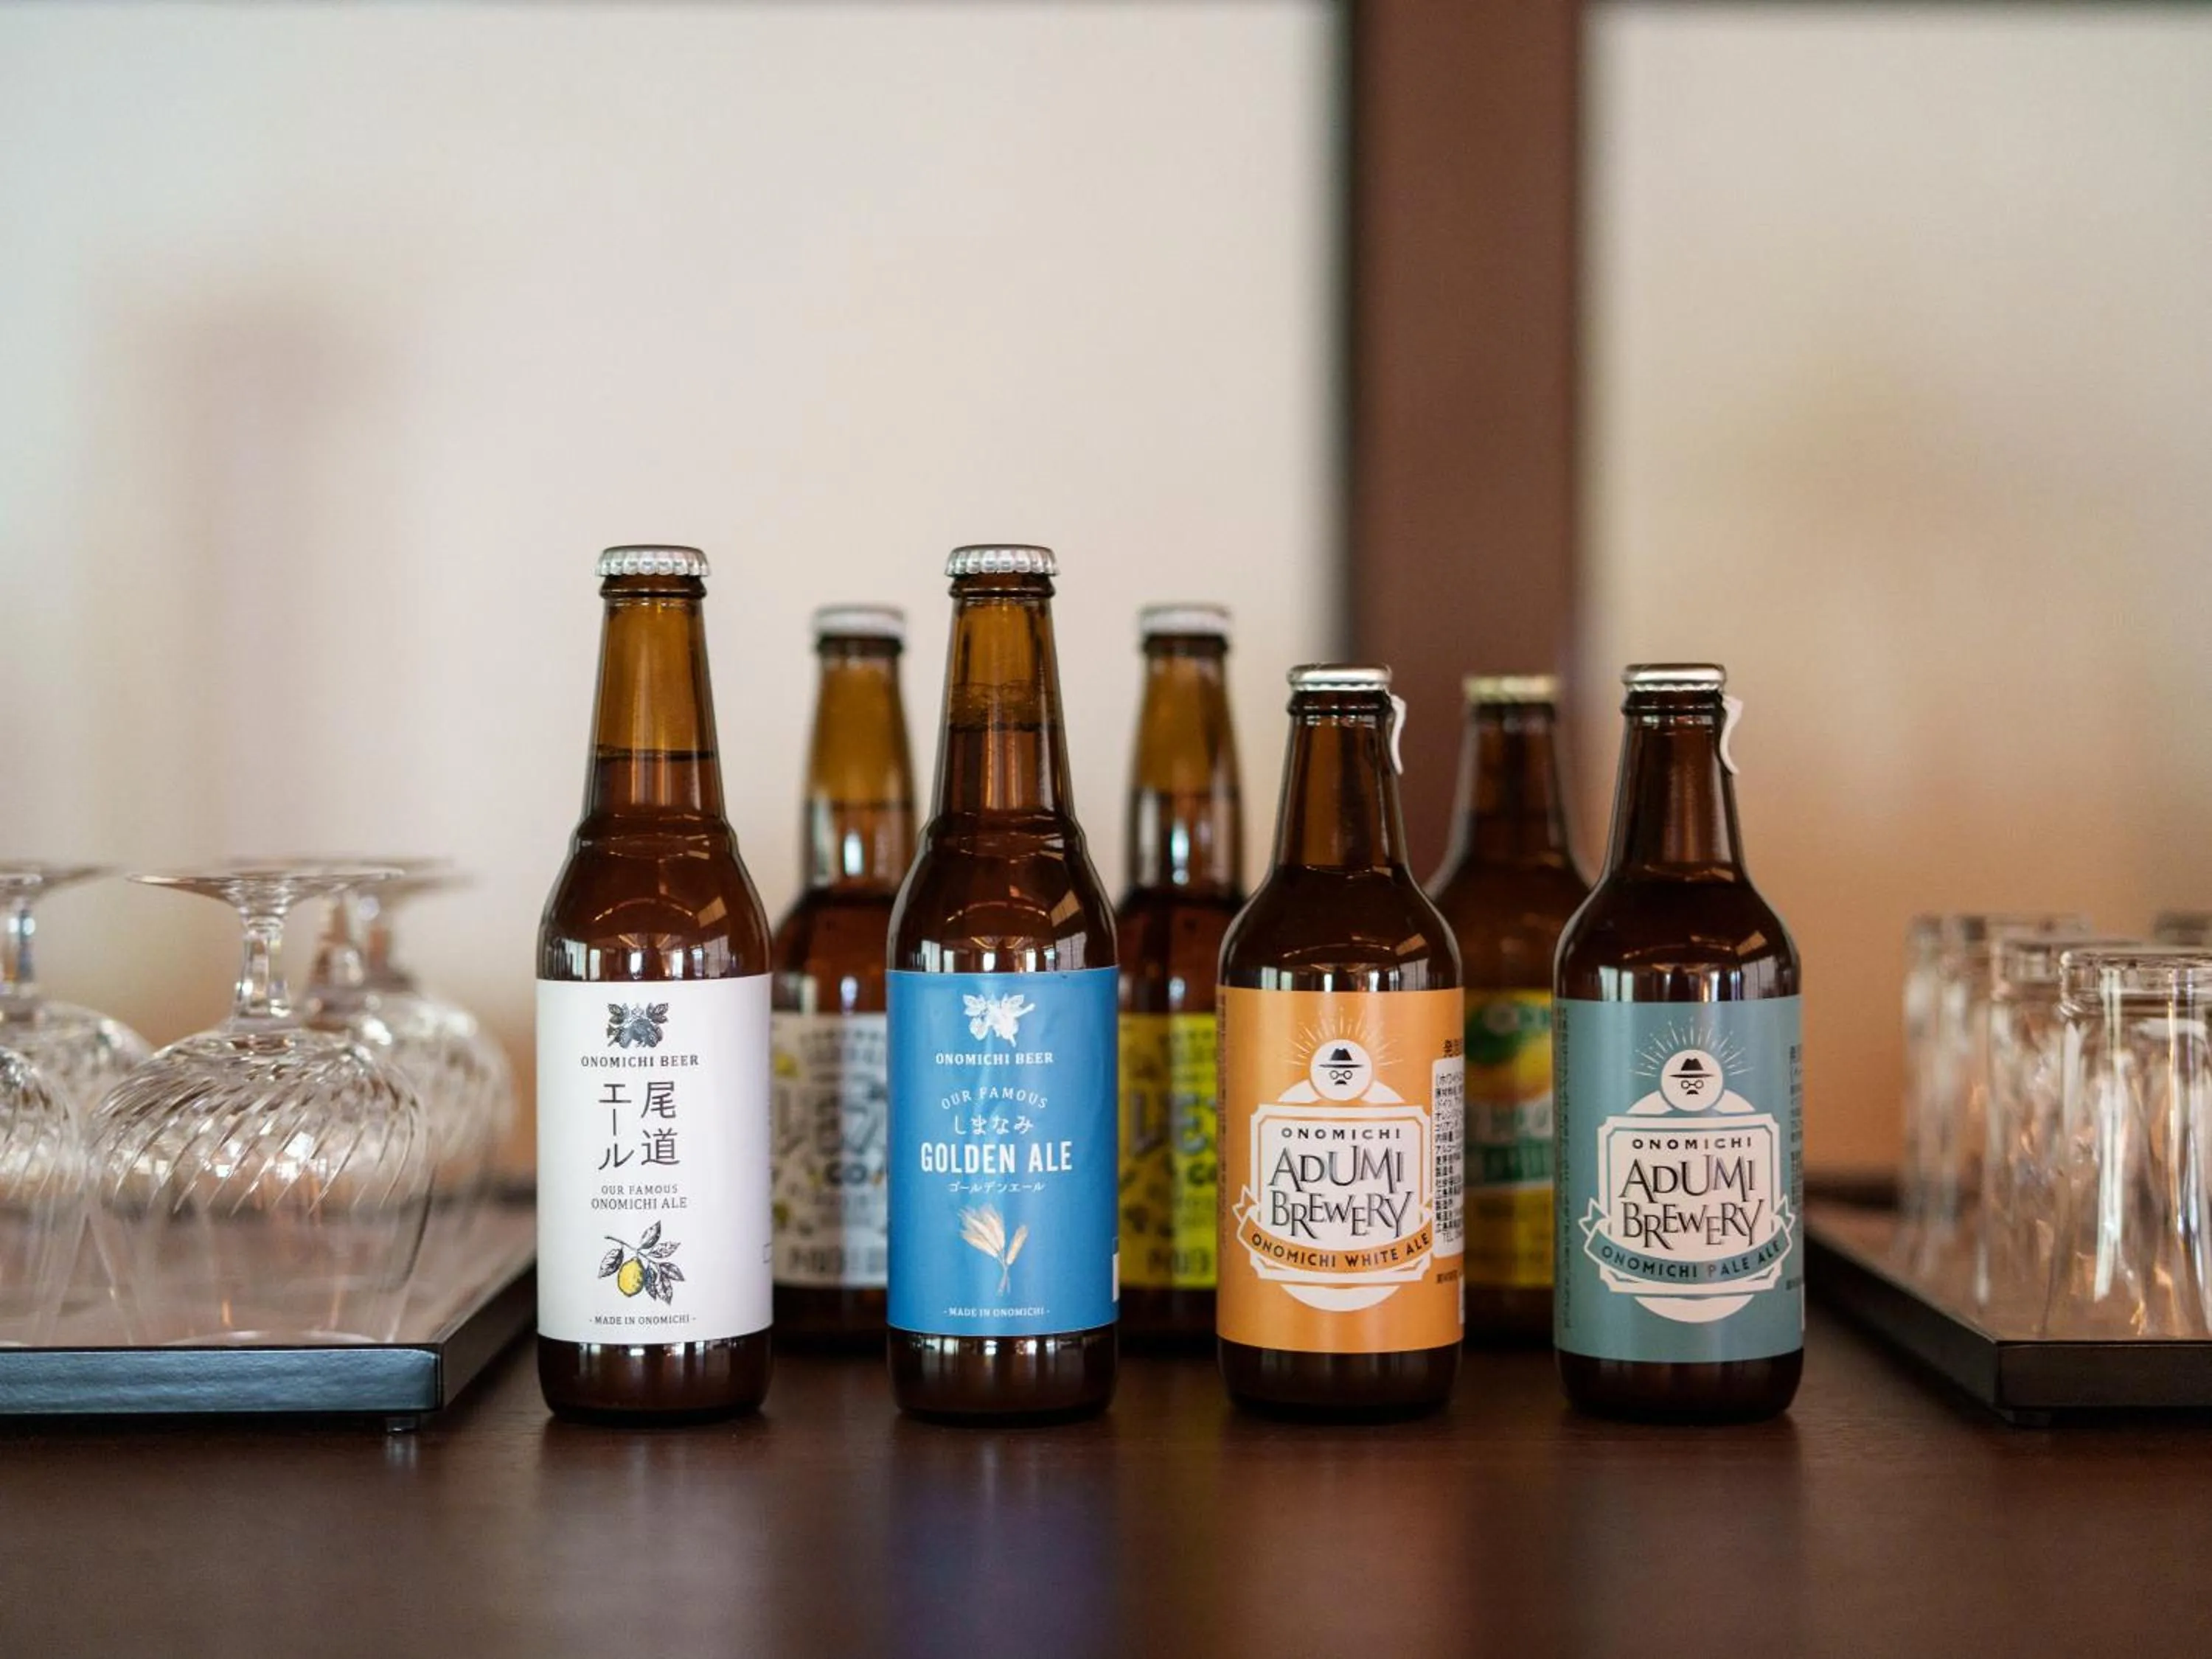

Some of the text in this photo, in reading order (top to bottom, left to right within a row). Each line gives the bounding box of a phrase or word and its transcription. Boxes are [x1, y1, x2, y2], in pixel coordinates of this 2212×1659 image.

[580, 1054, 699, 1068] ONOMICHI BEER
[936, 1052, 1054, 1066] ONOMICHI BEER
[941, 1086, 1048, 1110] OUR FAMOUS
[598, 1083, 635, 1170] エール
[641, 1081, 680, 1166] 尾道
[955, 1114, 1034, 1135] しまなみ
[1281, 1127, 1400, 1140] ONOMICHI
[1632, 1137, 1752, 1150] ONOMICHI
[921, 1141, 1073, 1174] GOLDEN ALE
[1267, 1145, 1405, 1194] ADUMI
[1618, 1155, 1756, 1203] ADUMI
[601, 1184, 678, 1195] OUR FAMOUS
[948, 1180, 1046, 1194] ゴールデンエール
[591, 1197, 687, 1210] ONOMICHI ALE
[1270, 1190, 1413, 1240] BREWERY
[1621, 1199, 1765, 1251] BREWERY
[1251, 1232, 1430, 1268] ONOMICHI WHITE ALE
[1601, 1240, 1780, 1279] ONOMICHI PALE ALE
[594, 1314, 689, 1326] MADE IN ONOMICHI
[948, 1307, 1044, 1318] MADE IN ONOMICHI
